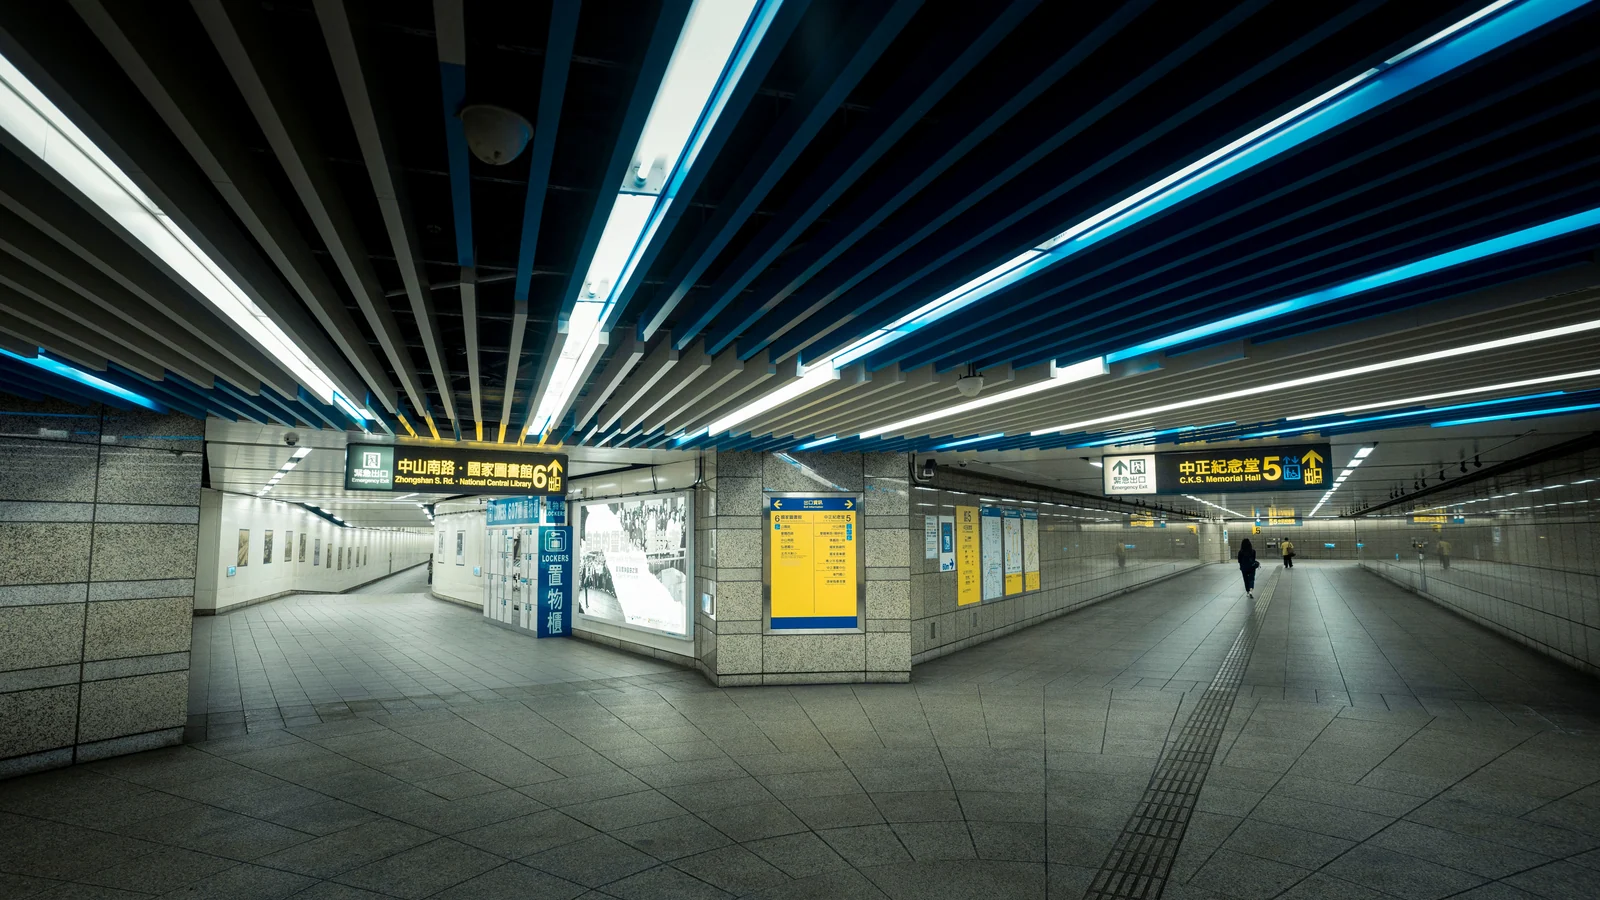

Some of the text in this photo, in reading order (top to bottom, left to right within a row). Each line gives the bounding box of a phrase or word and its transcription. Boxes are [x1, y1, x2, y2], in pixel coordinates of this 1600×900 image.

[354, 468, 388, 478] 緊急出口
[1180, 458, 1260, 476] 中正紀念堂
[1262, 456, 1282, 481] 5
[395, 476, 433, 486] Zhongshan
[460, 478, 485, 486] National
[487, 478, 509, 487] Central
[510, 479, 532, 489] Library
[532, 464, 547, 488] 6
[548, 476, 562, 492] 出口
[1113, 476, 1146, 484] 緊急出口
[1180, 473, 1261, 484] C.K.S. Memorial Hall
[1304, 468, 1322, 484] 出口
[548, 565, 563, 634] 置物櫃
